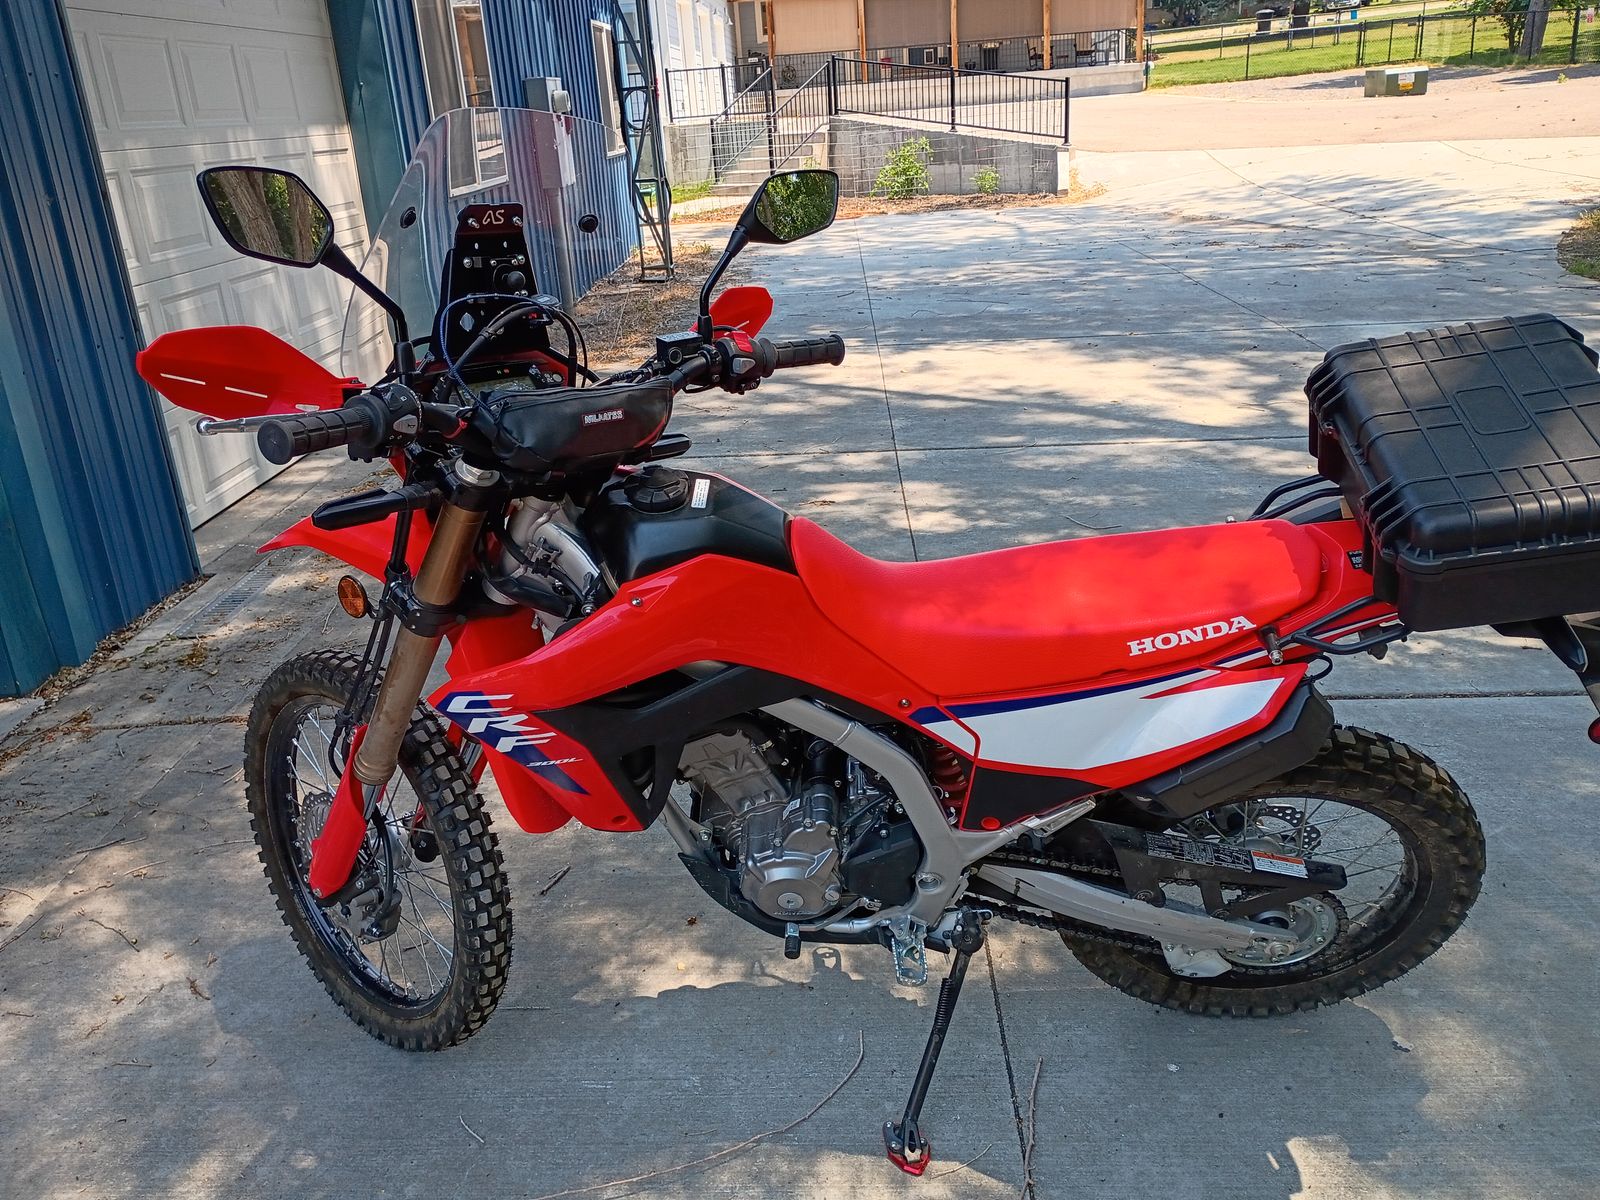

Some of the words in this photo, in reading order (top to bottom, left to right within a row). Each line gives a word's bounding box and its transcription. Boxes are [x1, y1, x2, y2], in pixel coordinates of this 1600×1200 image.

[1127, 615, 1257, 657] HONDA
[446, 693, 558, 753] CRF
[526, 757, 584, 767] 300L
